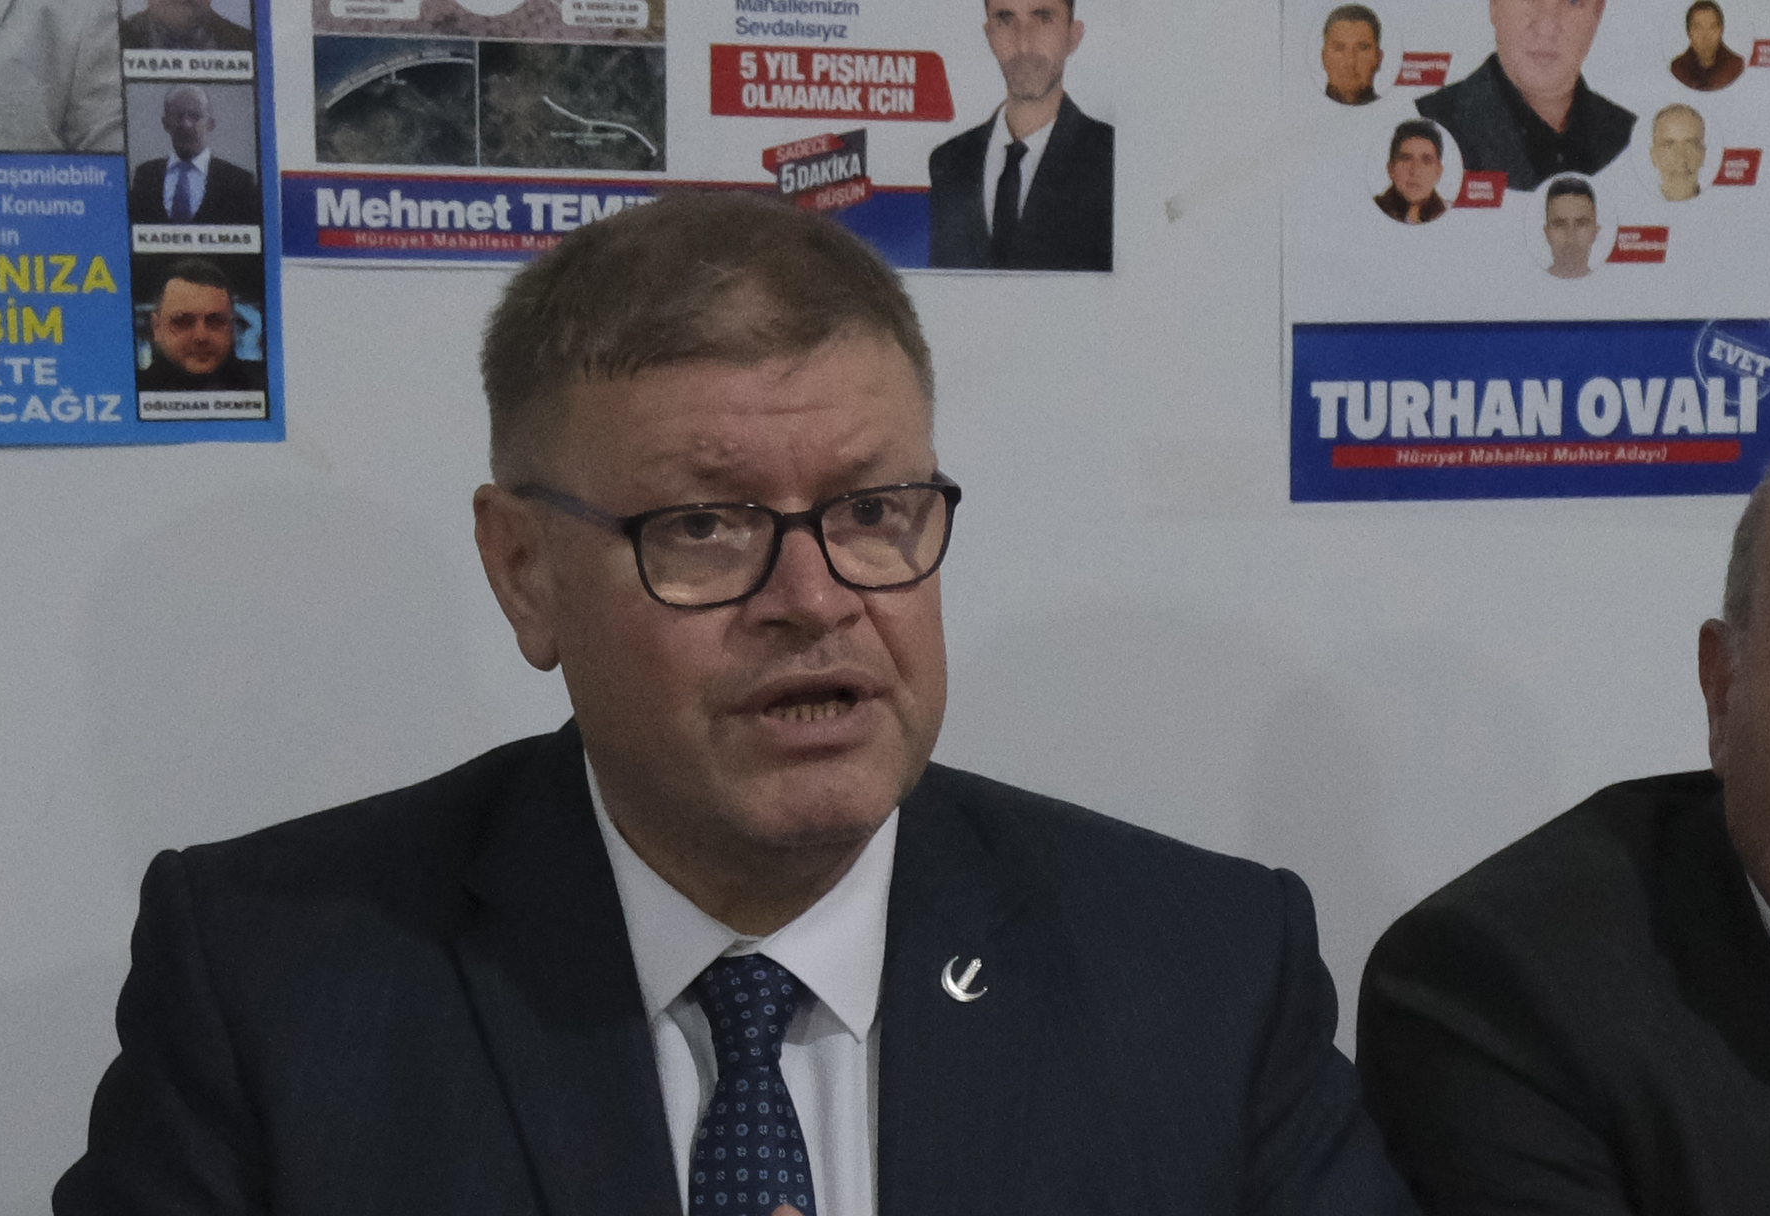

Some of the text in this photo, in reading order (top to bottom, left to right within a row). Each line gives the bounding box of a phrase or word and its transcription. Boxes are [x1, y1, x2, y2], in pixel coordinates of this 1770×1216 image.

[189, 58, 250, 70] DURAN
[740, 51, 757, 80] 5
[765, 52, 805, 81] YIL
[742, 83, 863, 111] OLMAMAK
[1, 194, 85, 215] Konuma
[316, 188, 657, 231] Mehmet TEM
[137, 232, 252, 245] KADER ELMAS
[1310, 375, 1759, 440] TURHAN OVALI
[1396, 449, 1465, 467] Hürriyet
